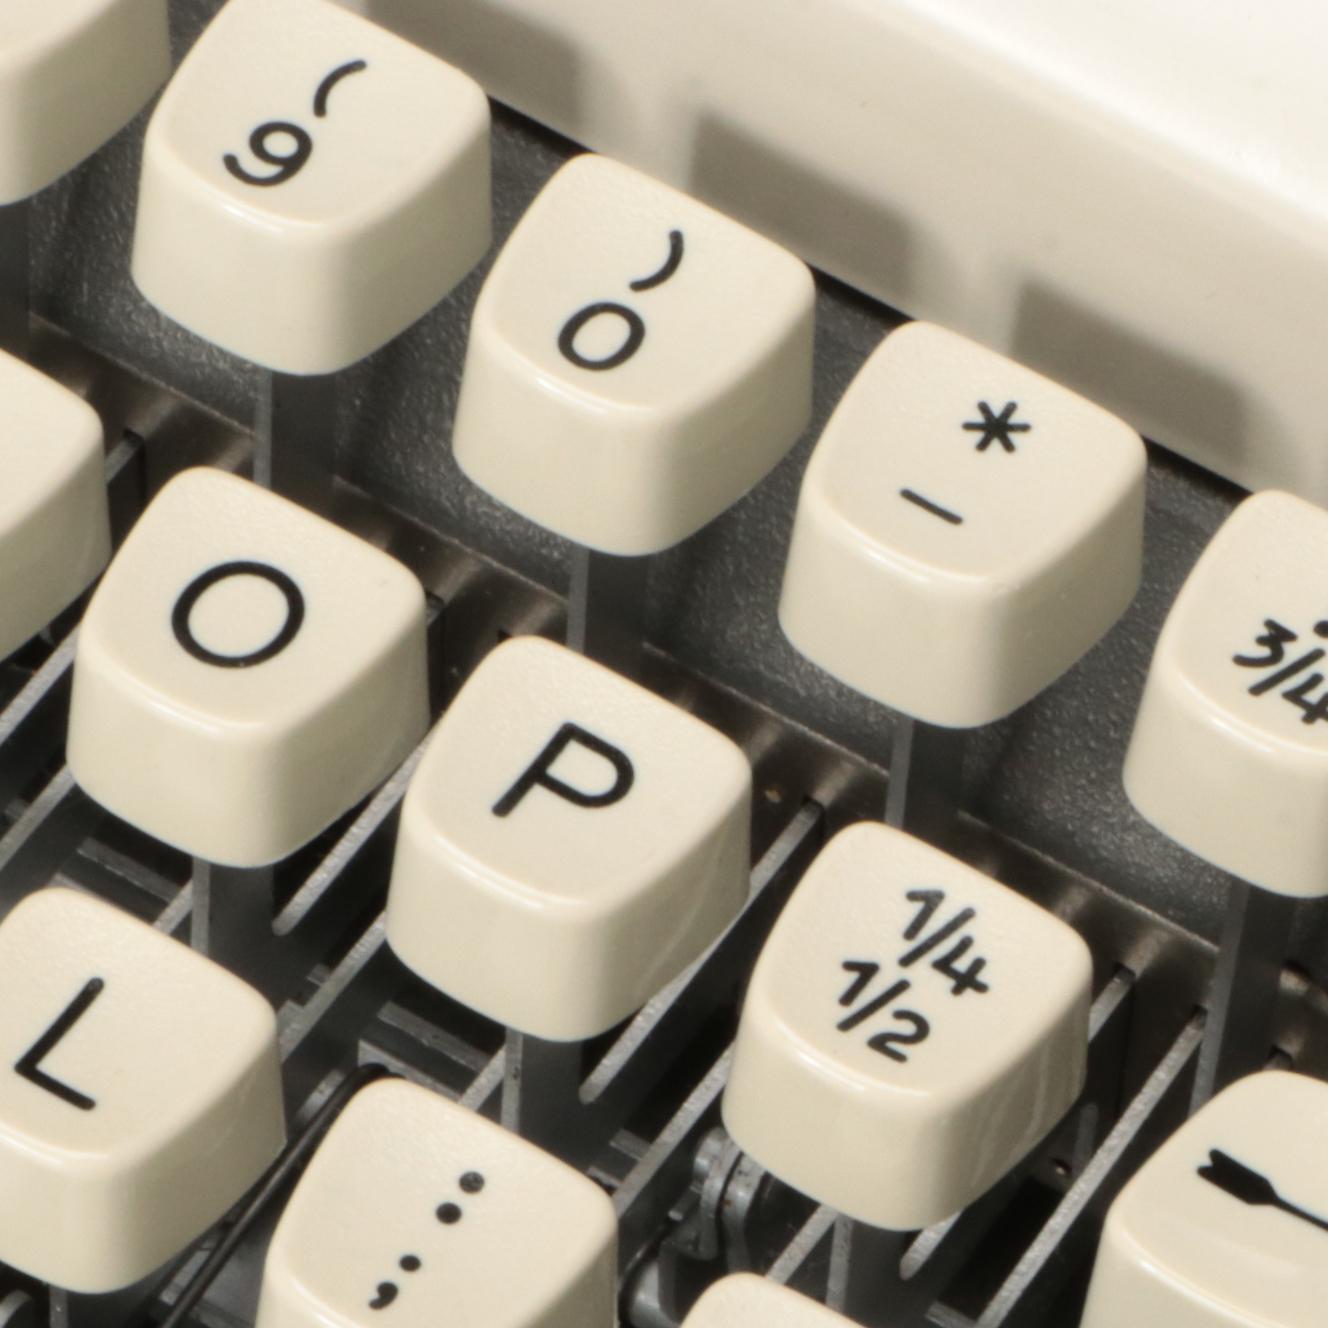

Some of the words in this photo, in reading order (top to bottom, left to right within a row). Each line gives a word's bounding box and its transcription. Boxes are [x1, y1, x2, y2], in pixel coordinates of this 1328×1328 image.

[223, 122, 312, 187] 9
[171, 561, 305, 668] O
[492, 723, 634, 817] P
[14, 977, 104, 1111] L
